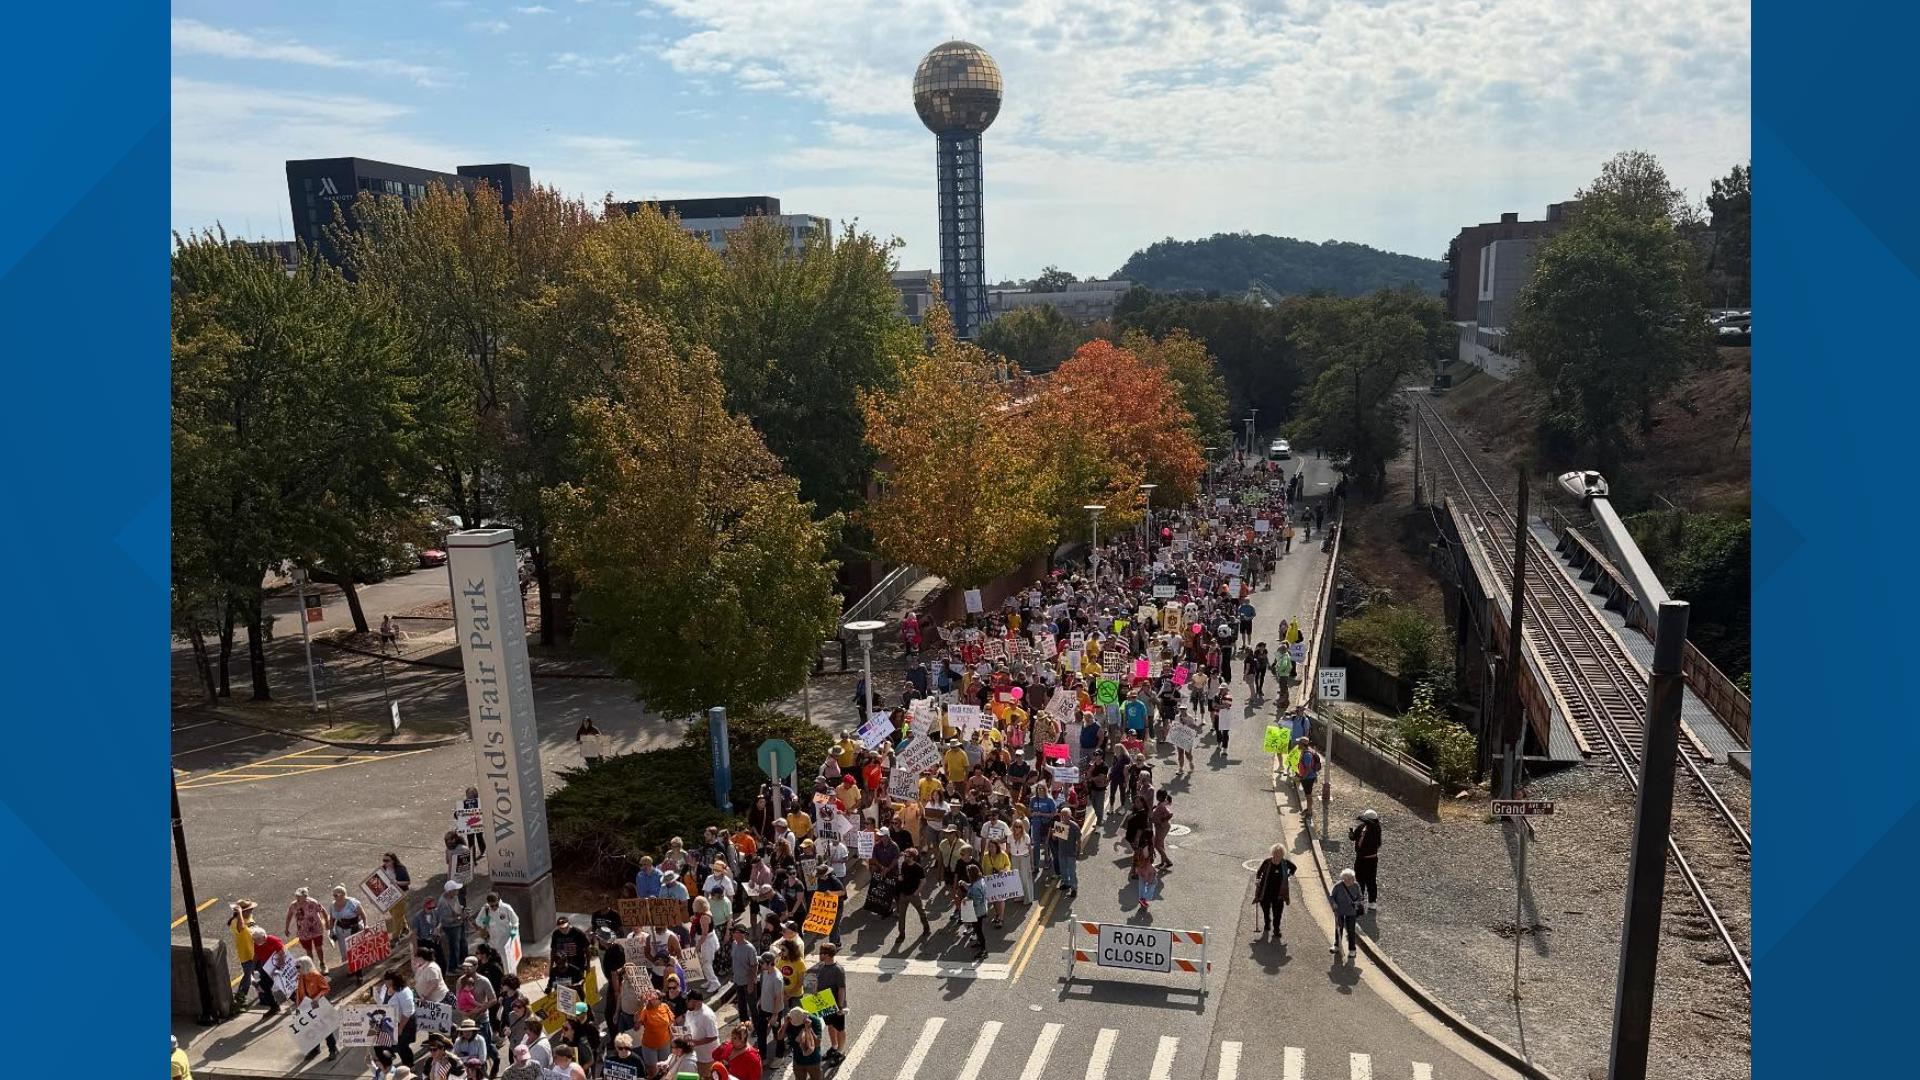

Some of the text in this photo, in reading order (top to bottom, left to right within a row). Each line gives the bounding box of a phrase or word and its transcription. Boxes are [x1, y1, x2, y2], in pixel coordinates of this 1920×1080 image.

[1322, 685, 1341, 697] 15
[463, 578, 515, 844] World's Fair Park
[1493, 802, 1526, 814] Grand
[823, 821, 832, 830] NO
[498, 848, 515, 857] City
[491, 869, 526, 879] Knoxville
[1113, 931, 1156, 948] ROAD
[351, 936, 385, 959] RESISTS
[1104, 947, 1165, 966] CLOSED
[289, 1009, 318, 1034] ICE
